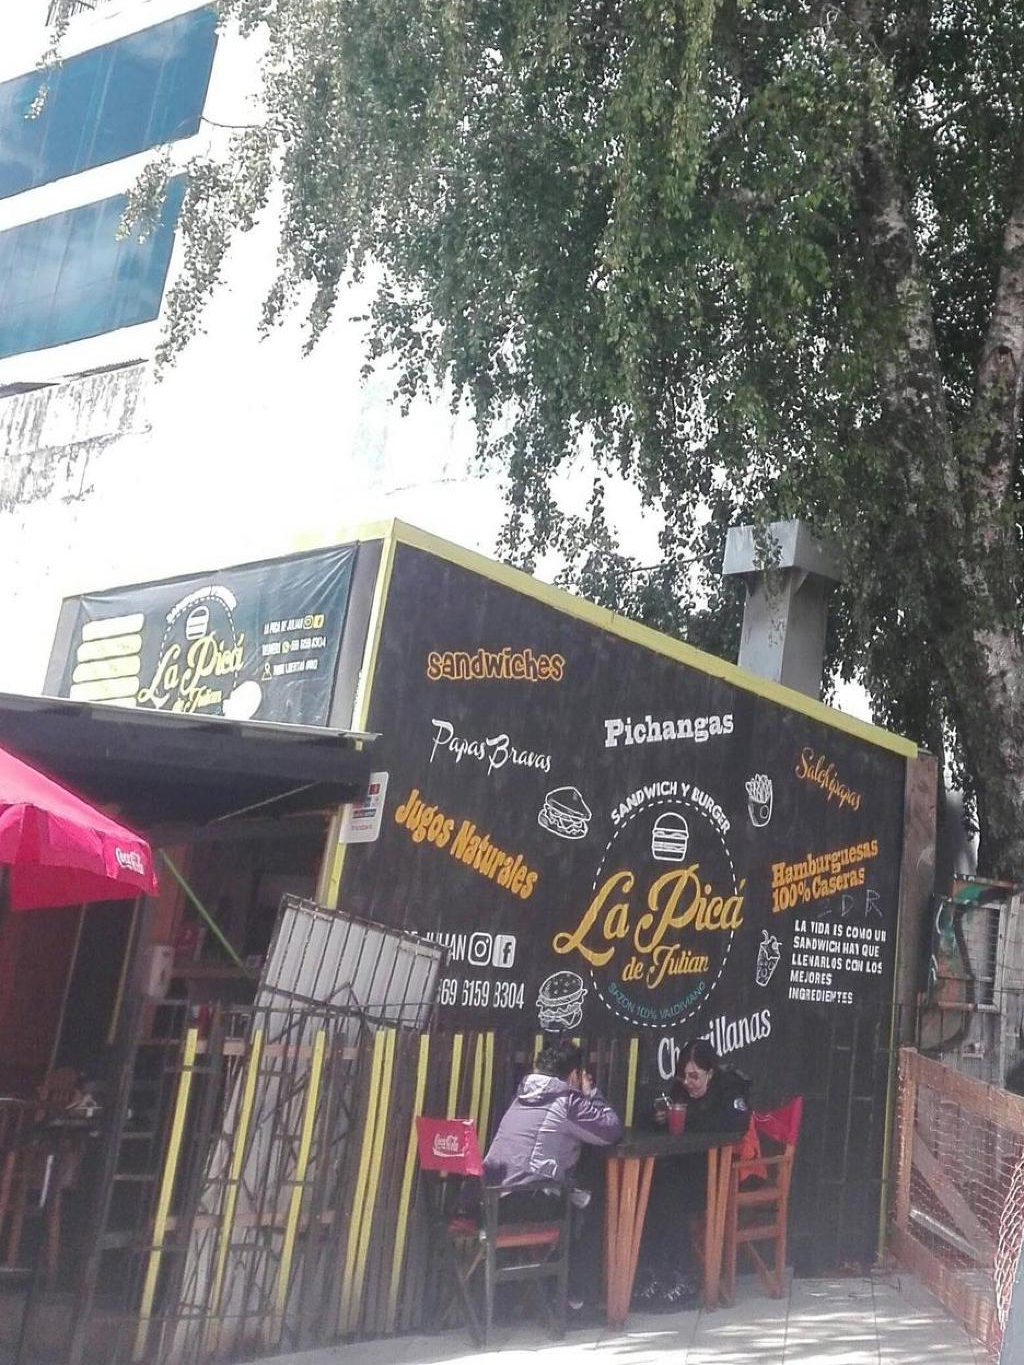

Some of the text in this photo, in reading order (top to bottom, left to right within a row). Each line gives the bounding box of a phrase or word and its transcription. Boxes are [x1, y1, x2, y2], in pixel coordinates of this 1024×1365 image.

[427, 647, 565, 682] sandwiches
[430, 718, 552, 776] Papas Bravas
[604, 714, 734, 748] Pichangas
[795, 746, 861, 812] Salchipapas
[611, 781, 731, 835] SANDWICH Y BURGER
[394, 788, 538, 900] Jugos Naturales
[771, 839, 879, 889] Hamburguesas
[772, 867, 866, 914] 100% Caseras
[552, 863, 747, 967] La Picá
[794, 919, 807, 933] LA
[810, 921, 830, 935] VIDA
[845, 925, 873, 941] COMO
[622, 943, 710, 990] de Julian
[791, 953, 883, 975] LLEVARLOS CON LOS
[793, 935, 881, 958] SANDWICH HAY QUE
[787, 986, 854, 1005] INGREDIENTES
[789, 969, 833, 985] MEJORES
